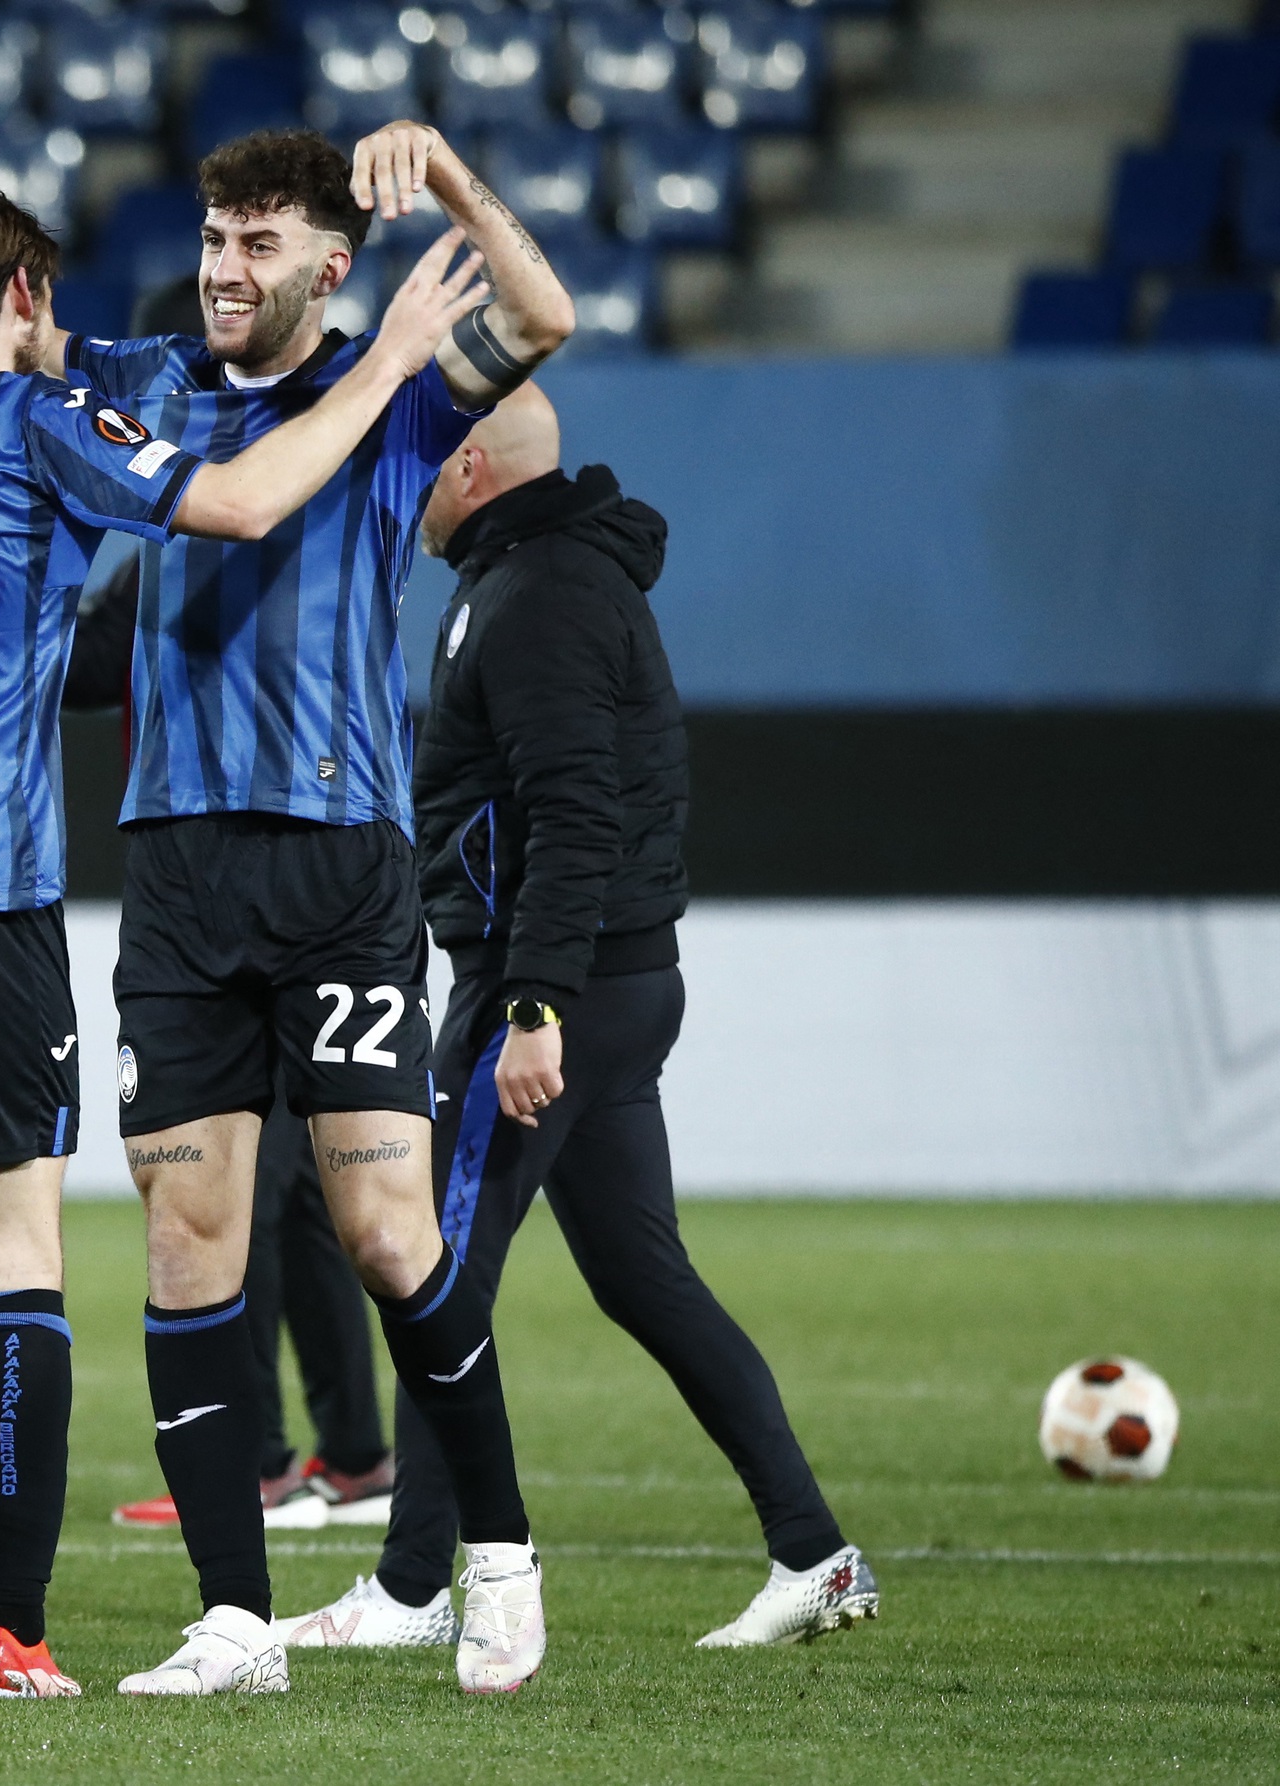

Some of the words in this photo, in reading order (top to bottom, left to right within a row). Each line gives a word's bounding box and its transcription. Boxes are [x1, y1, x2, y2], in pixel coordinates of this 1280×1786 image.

[311, 983, 406, 1069] 22
[130, 1145, 204, 1172] Isabella
[326, 1139, 411, 1173] Ermanno
[1, 1332, 23, 1420] ATALANTA
[0, 1422, 17, 1496] BERGAMO
